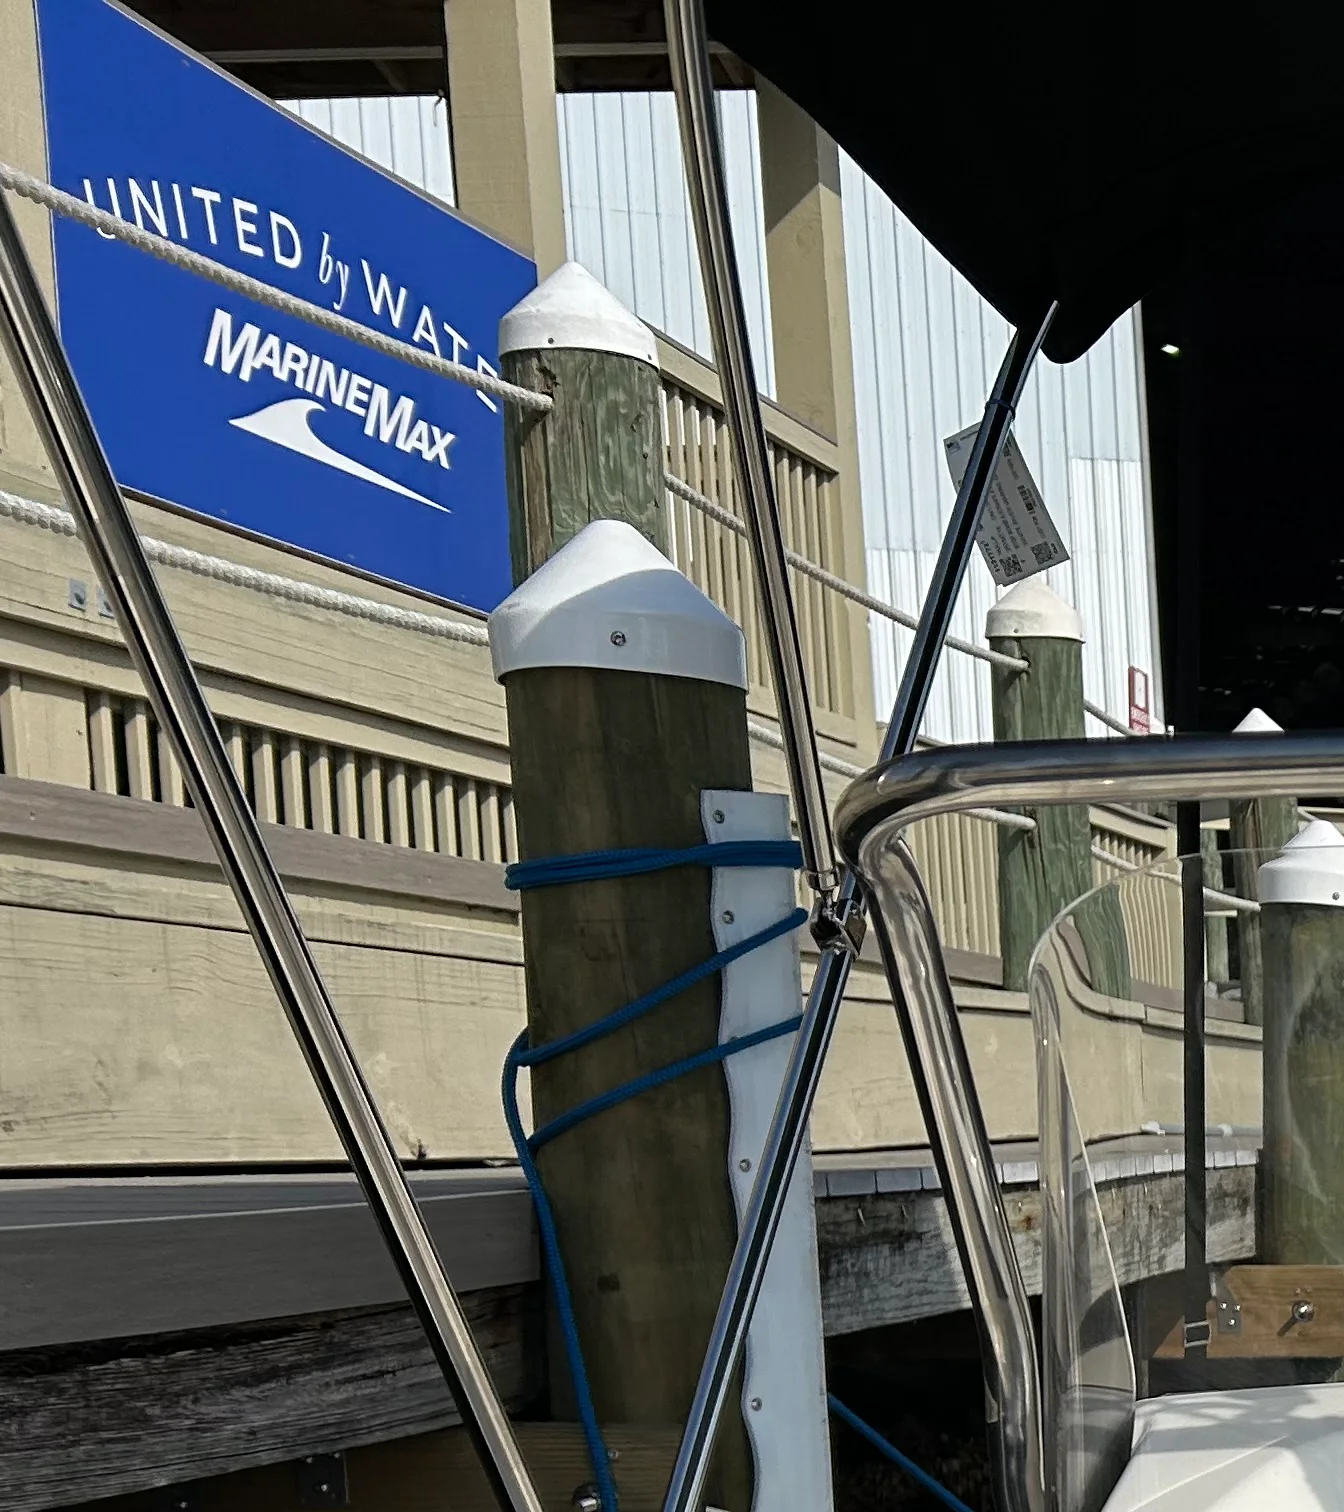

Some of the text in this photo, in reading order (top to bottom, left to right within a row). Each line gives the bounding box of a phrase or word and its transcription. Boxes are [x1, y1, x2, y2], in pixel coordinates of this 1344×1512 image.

[83, 177, 499, 414] UNITED by WATE
